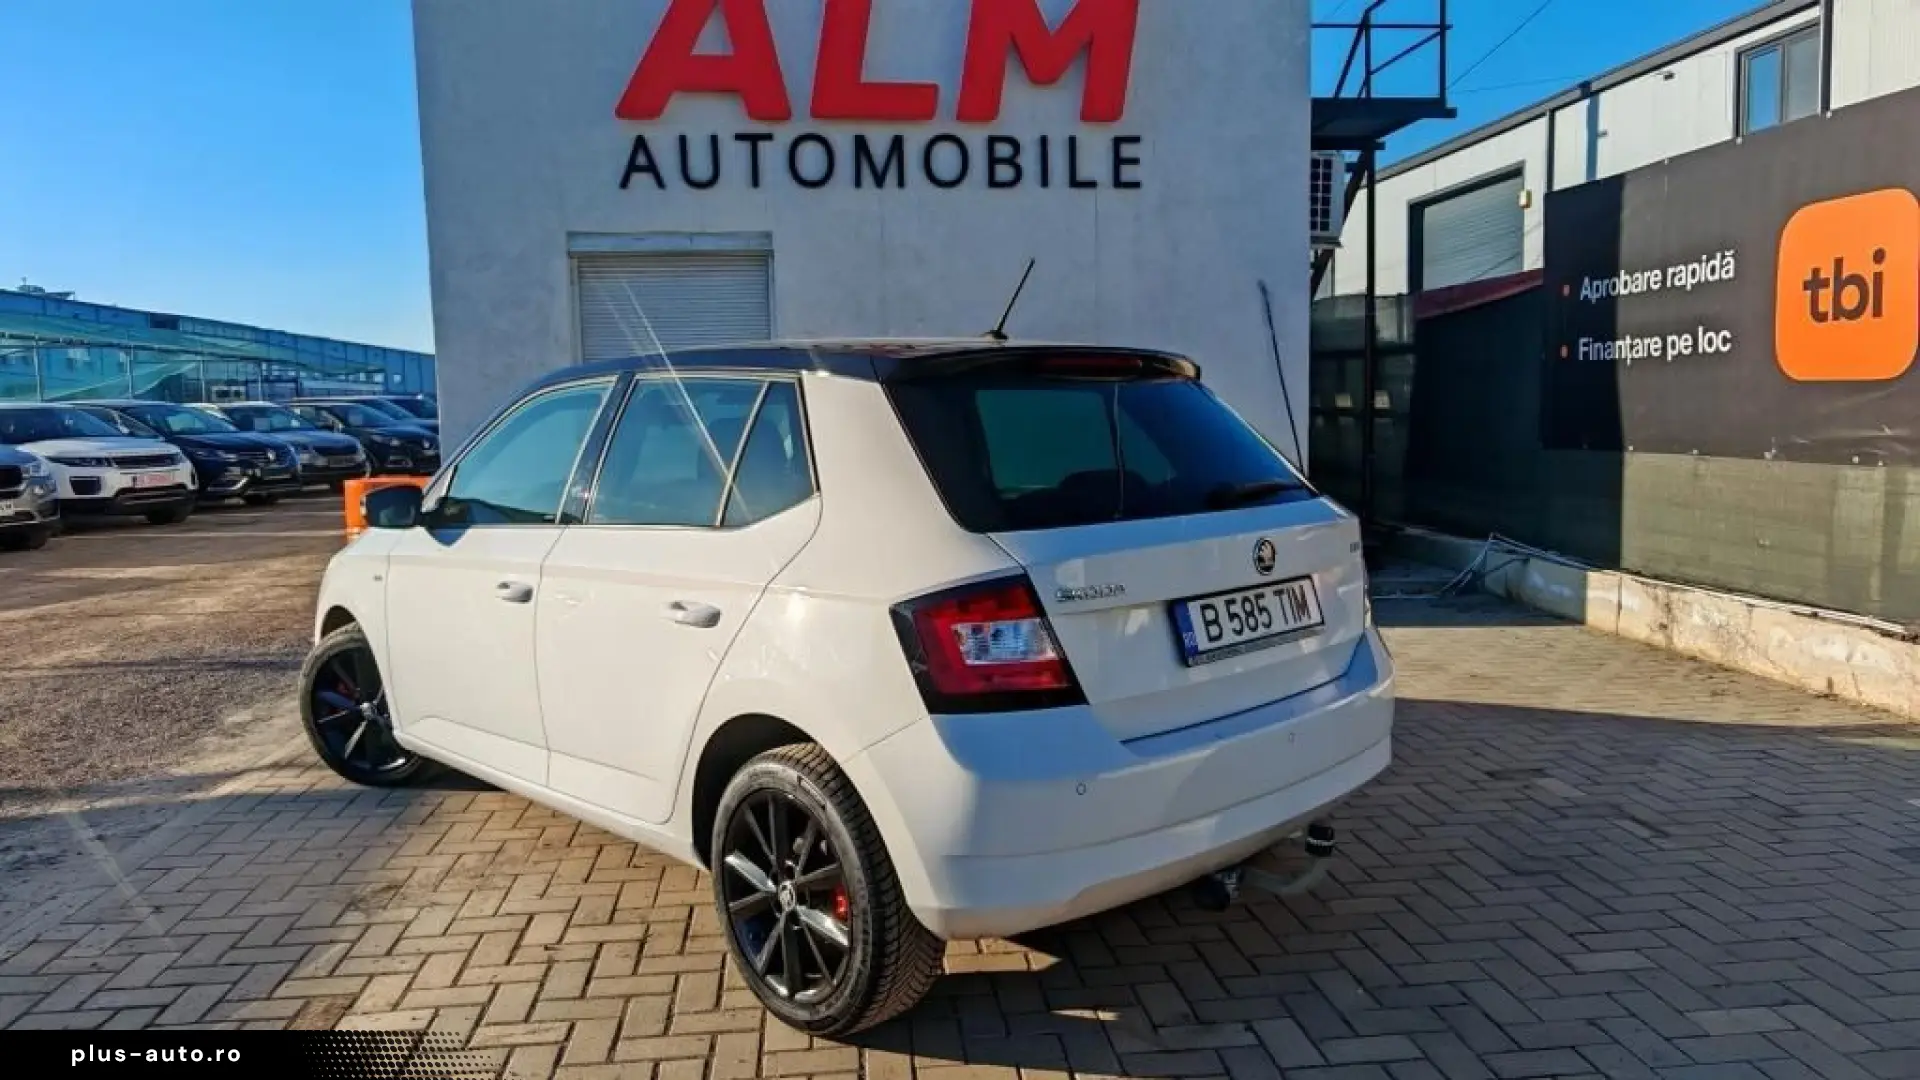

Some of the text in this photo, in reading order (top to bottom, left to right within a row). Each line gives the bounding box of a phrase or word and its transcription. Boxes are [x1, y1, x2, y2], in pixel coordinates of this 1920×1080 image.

[613, 0, 1140, 123] ALM
[619, 132, 1142, 189] AUTOMOBILE
[1579, 250, 1736, 302] Aprobare rapidă
[1803, 247, 1886, 323] tbi
[1577, 326, 1733, 365] Finanțare pe loc
[1200, 584, 1312, 642] B 585 TIM
